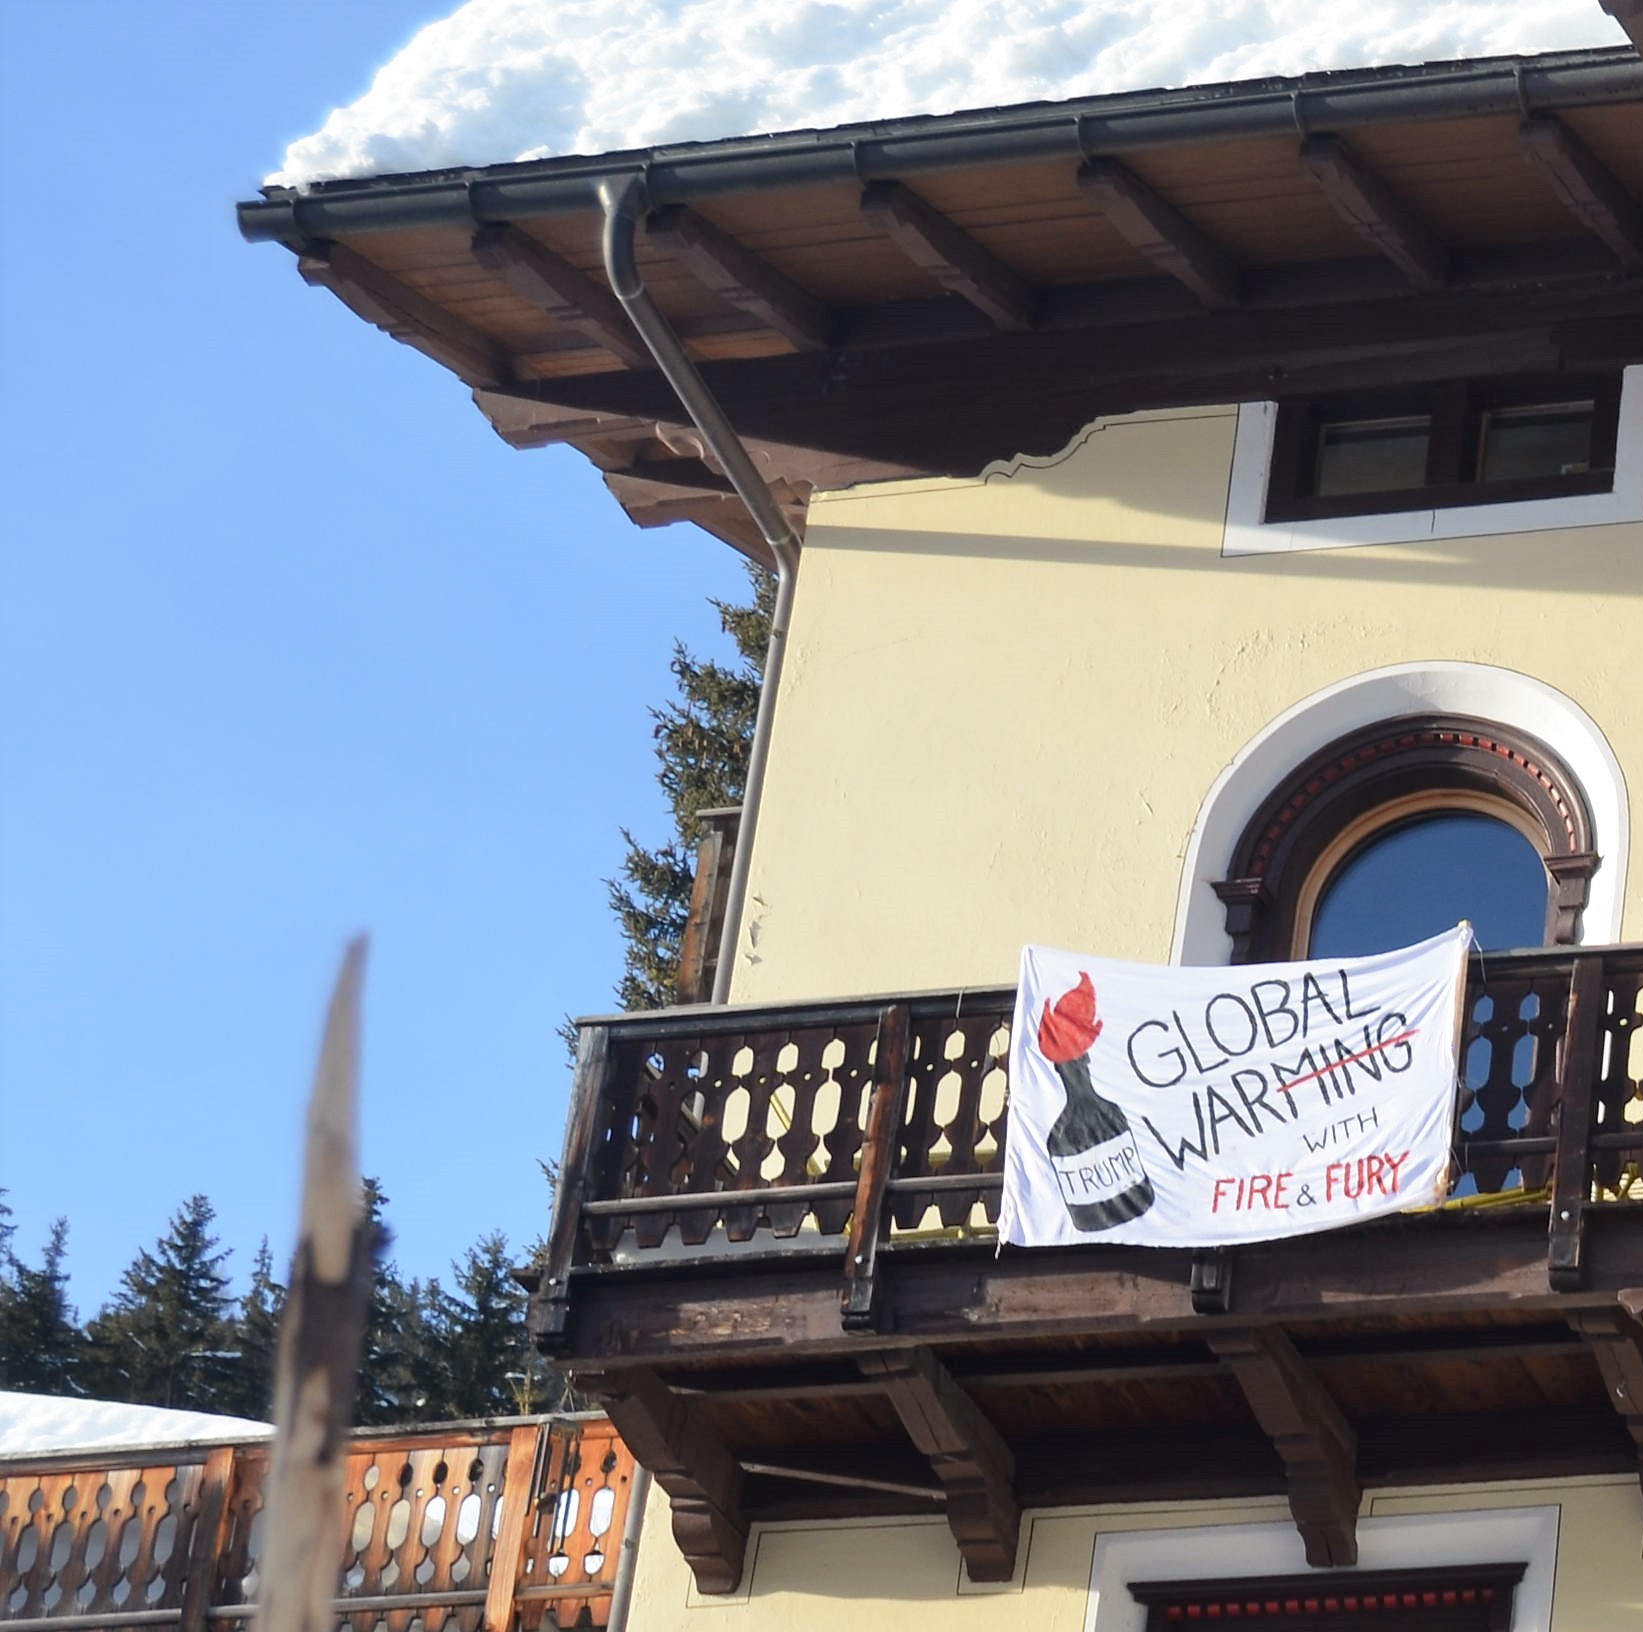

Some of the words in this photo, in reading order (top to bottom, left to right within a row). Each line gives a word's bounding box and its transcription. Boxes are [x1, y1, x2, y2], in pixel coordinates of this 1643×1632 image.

[1127, 968, 1381, 1088] GLOBAL
[1142, 1012, 1413, 1170] WARMING
[1303, 1106, 1379, 1153] WITH
[1058, 1146, 1135, 1195] TRUMP
[1211, 1171, 1294, 1214] FIRE
[1296, 1183, 1316, 1207] &
[1324, 1150, 1410, 1203] FURY
